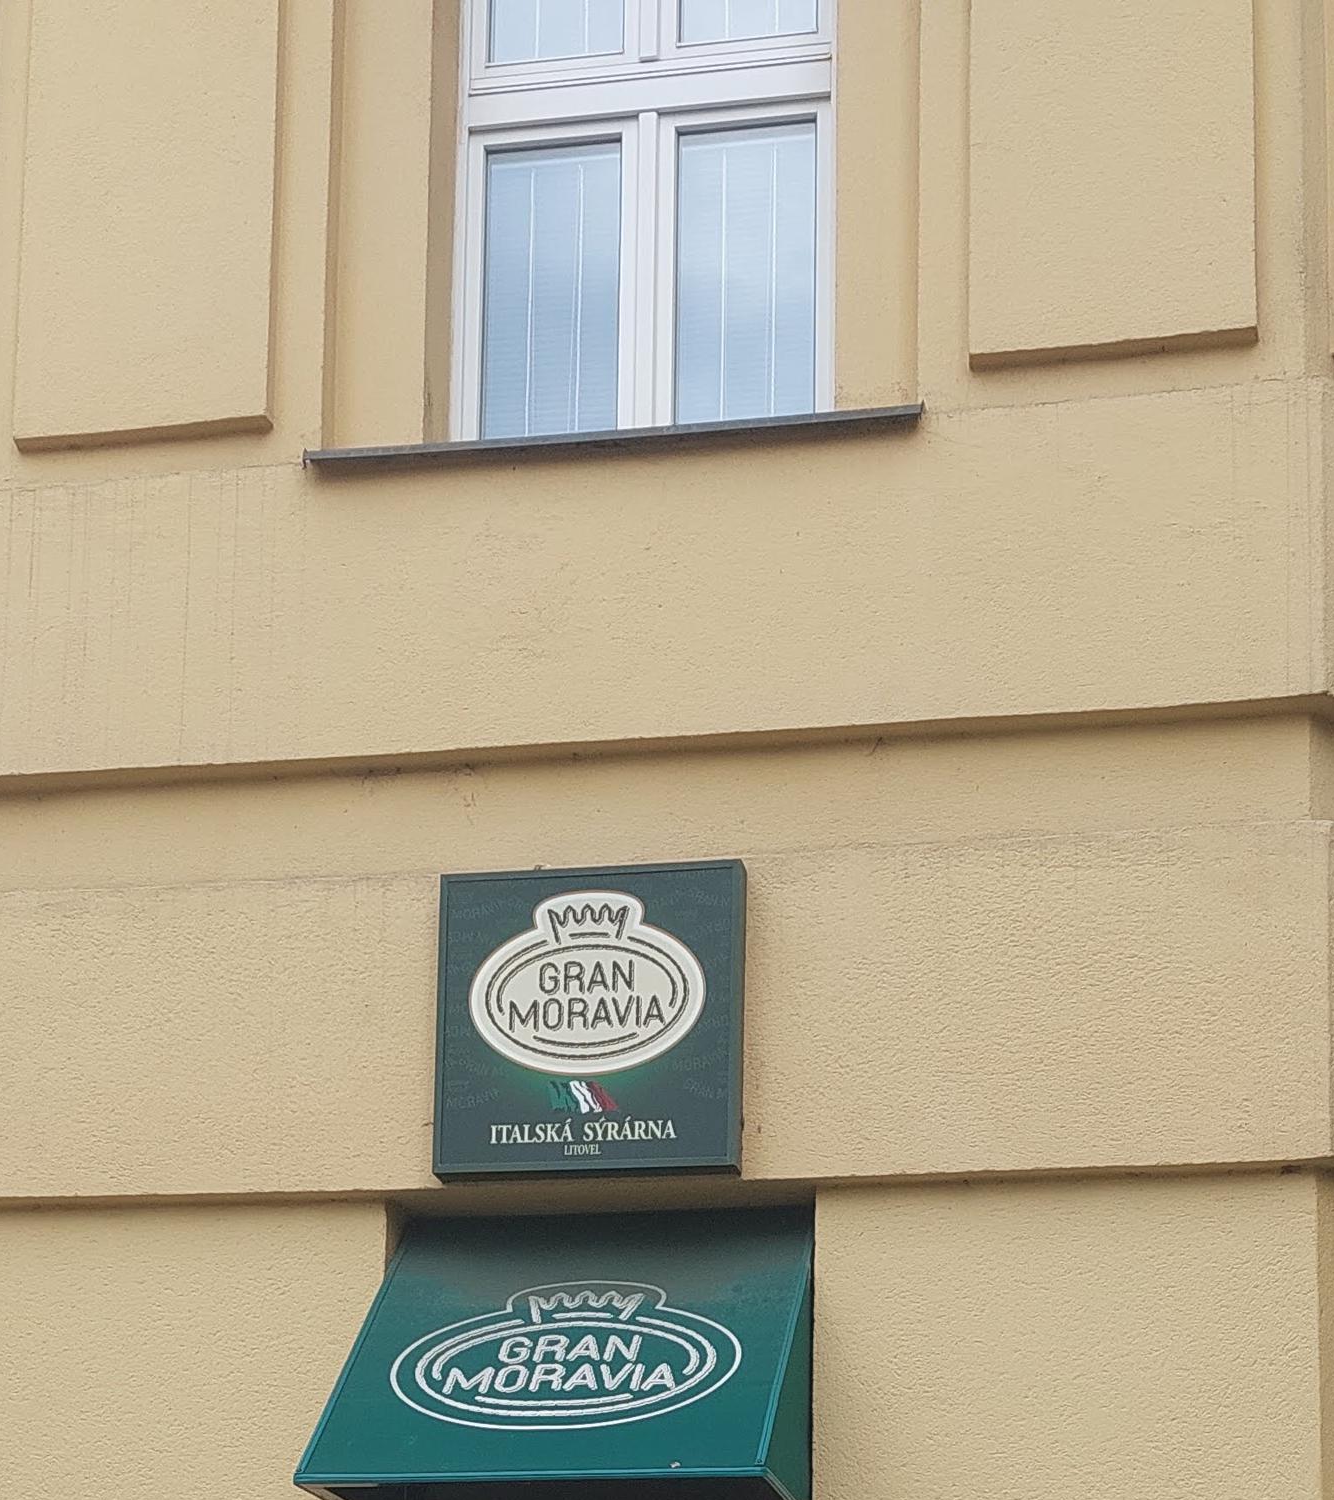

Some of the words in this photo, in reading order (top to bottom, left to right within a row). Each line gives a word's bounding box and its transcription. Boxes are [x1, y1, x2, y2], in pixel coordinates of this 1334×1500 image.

[539, 959, 636, 996] GRAN
[508, 994, 667, 1033] MORAVIA
[490, 1118, 576, 1145] ITALSKÁ
[583, 1114, 678, 1142] SÝRÁRNA
[563, 1143, 602, 1156] LITOVEL
[497, 1333, 643, 1364] GRAN
[442, 1363, 676, 1395] MORAVIA
